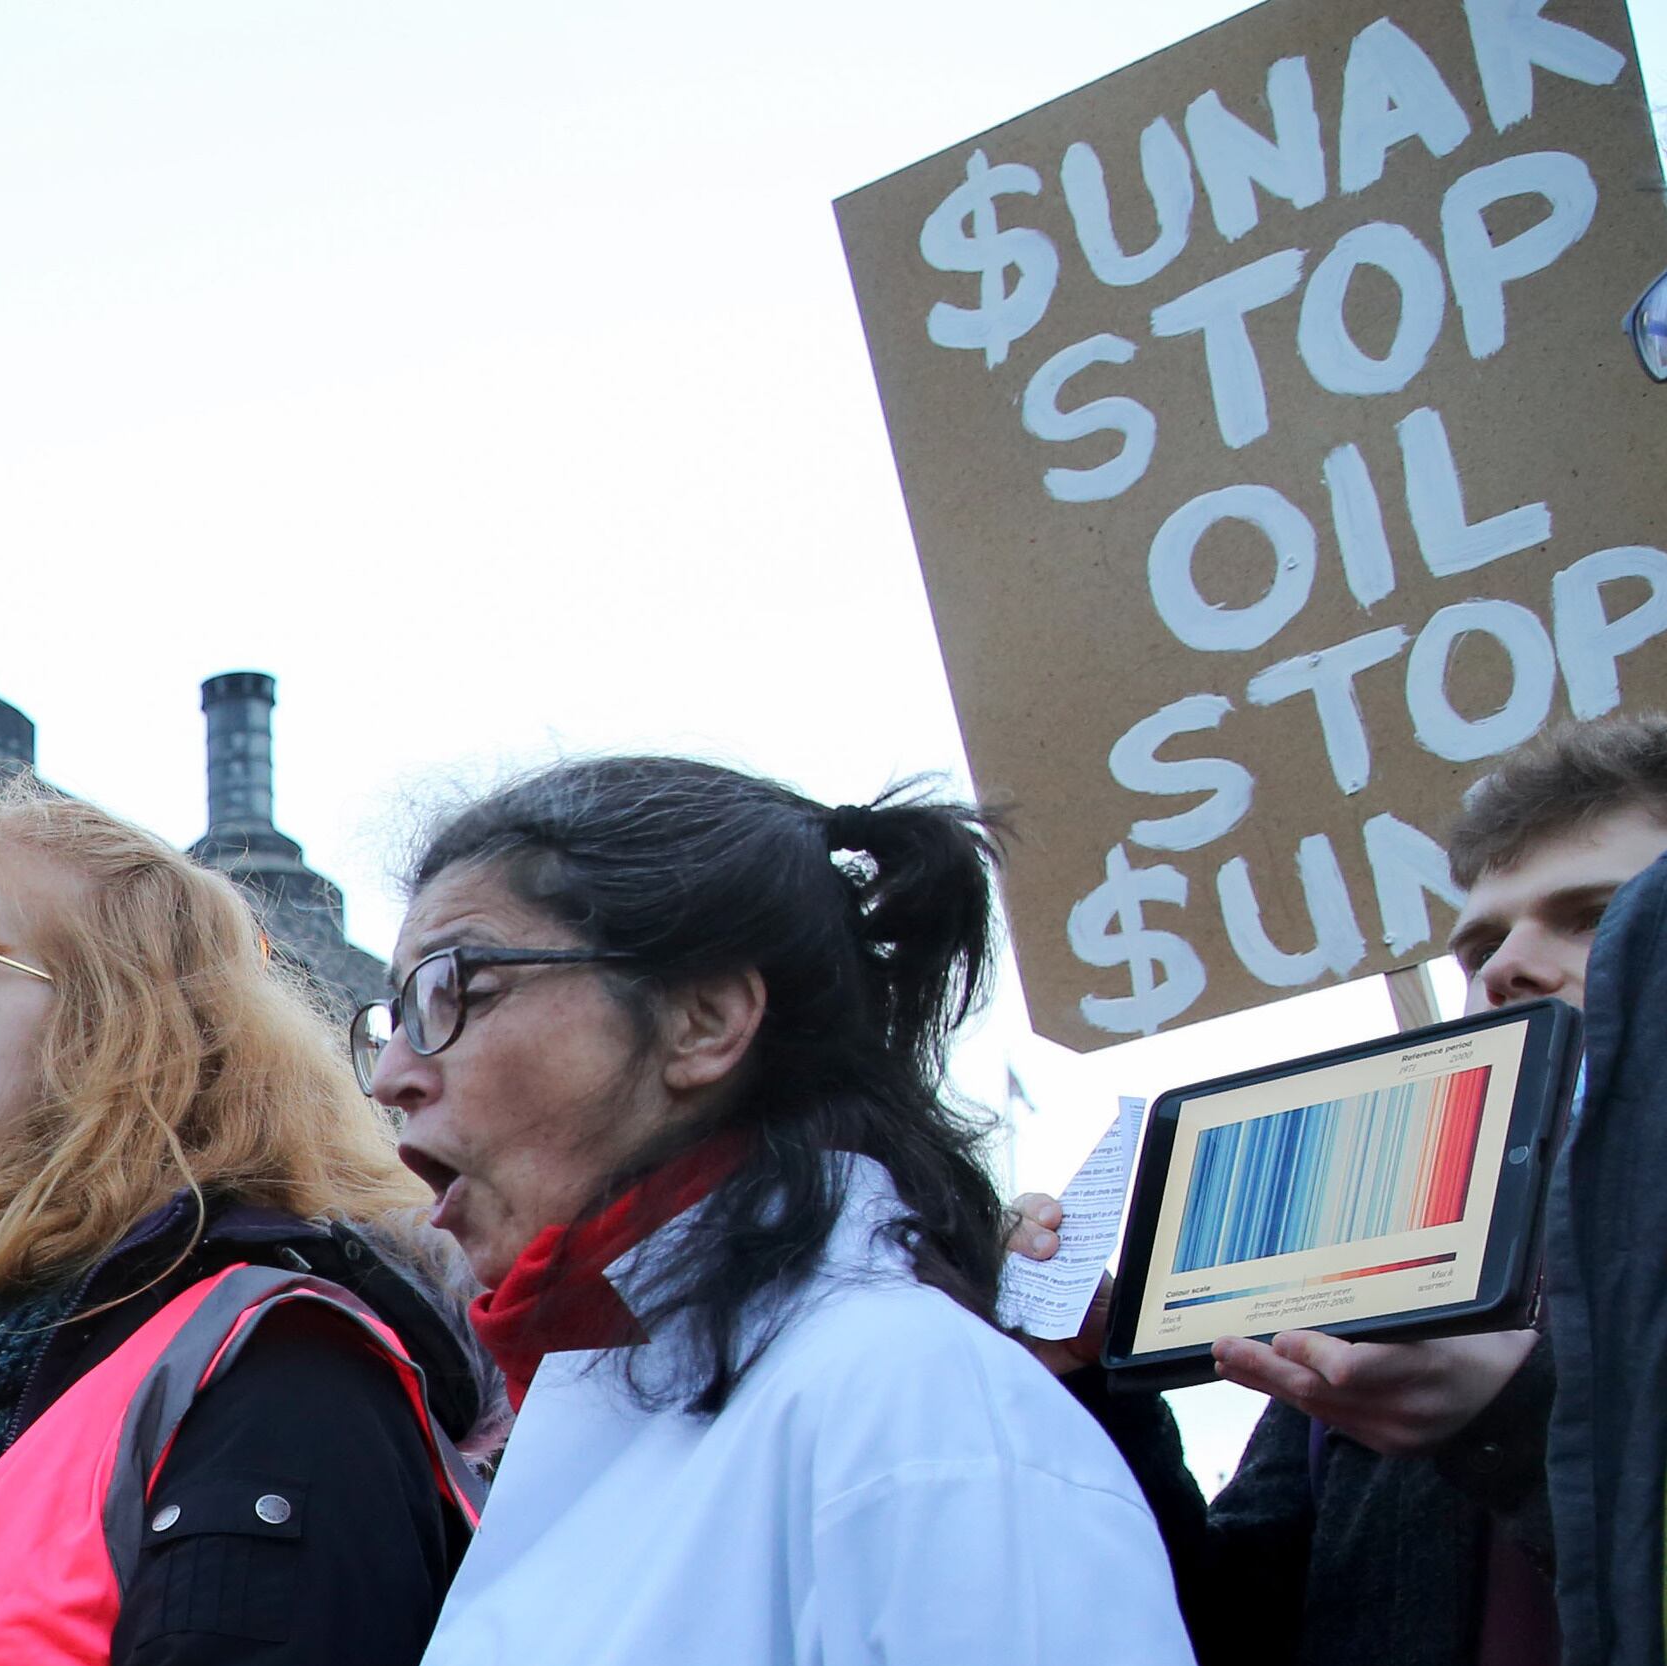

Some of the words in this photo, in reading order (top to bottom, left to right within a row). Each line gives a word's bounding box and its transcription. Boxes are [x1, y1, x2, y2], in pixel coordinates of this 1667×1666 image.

[1023, 151, 1597, 503] STOP
[1147, 406, 1551, 651] OIL
[1108, 545, 1667, 851] STOP
[1067, 812, 1467, 1035] $UN
